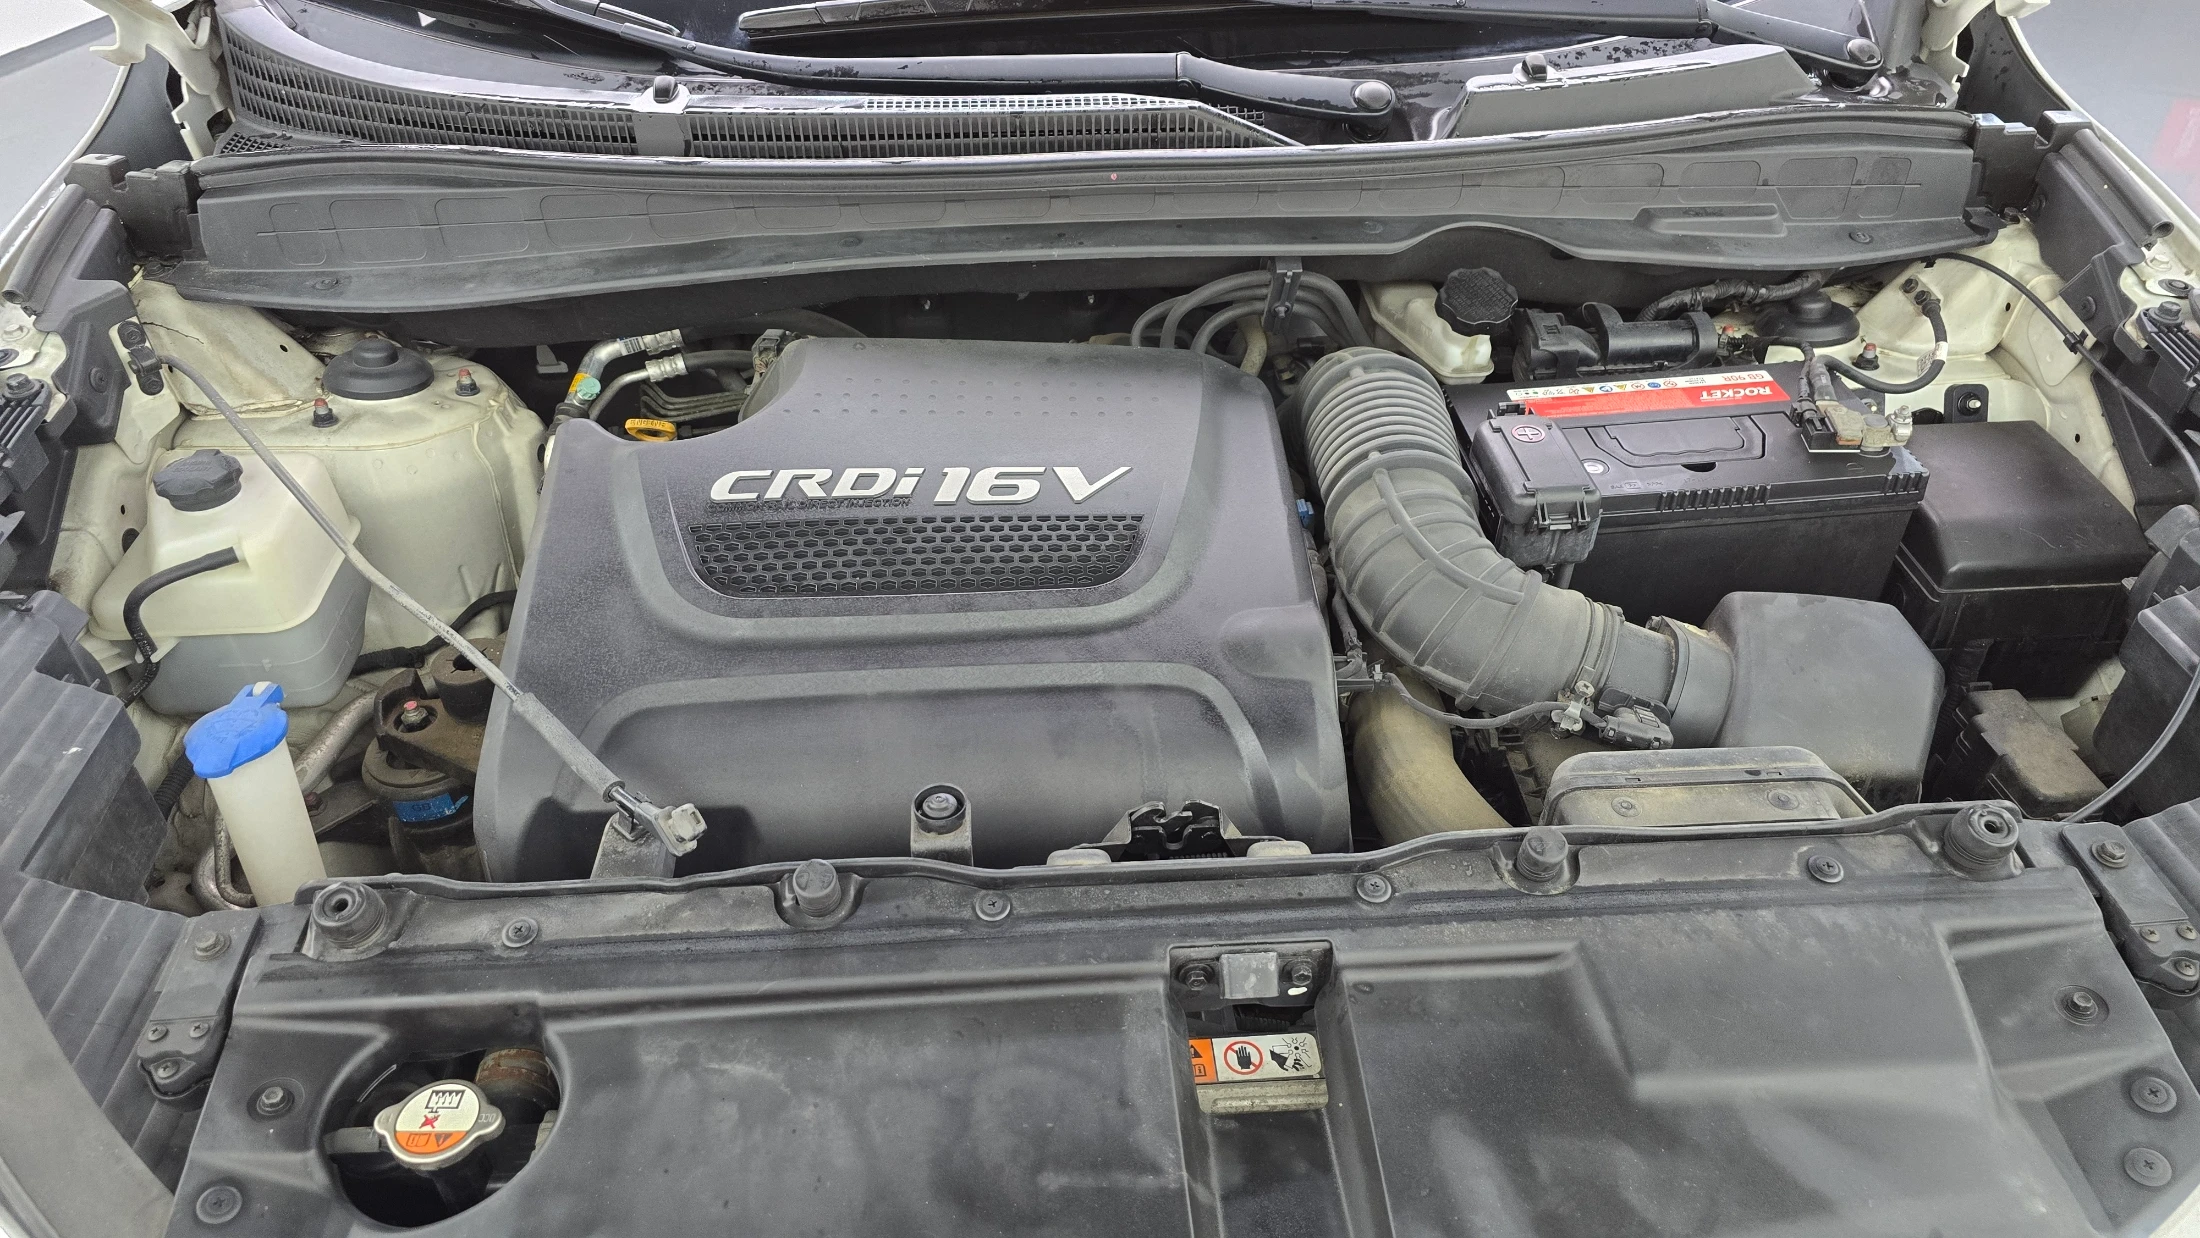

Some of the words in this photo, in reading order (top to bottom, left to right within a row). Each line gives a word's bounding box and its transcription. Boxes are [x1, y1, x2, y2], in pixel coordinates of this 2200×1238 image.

[1723, 374, 1746, 382] 90R
[1748, 373, 1764, 381] GB
[1699, 386, 1773, 400] ROCKET
[710, 467, 925, 504] CRDi
[933, 466, 1133, 506] 16V
[799, 499, 844, 509] DIRECT
[845, 499, 911, 508] INJECTION
